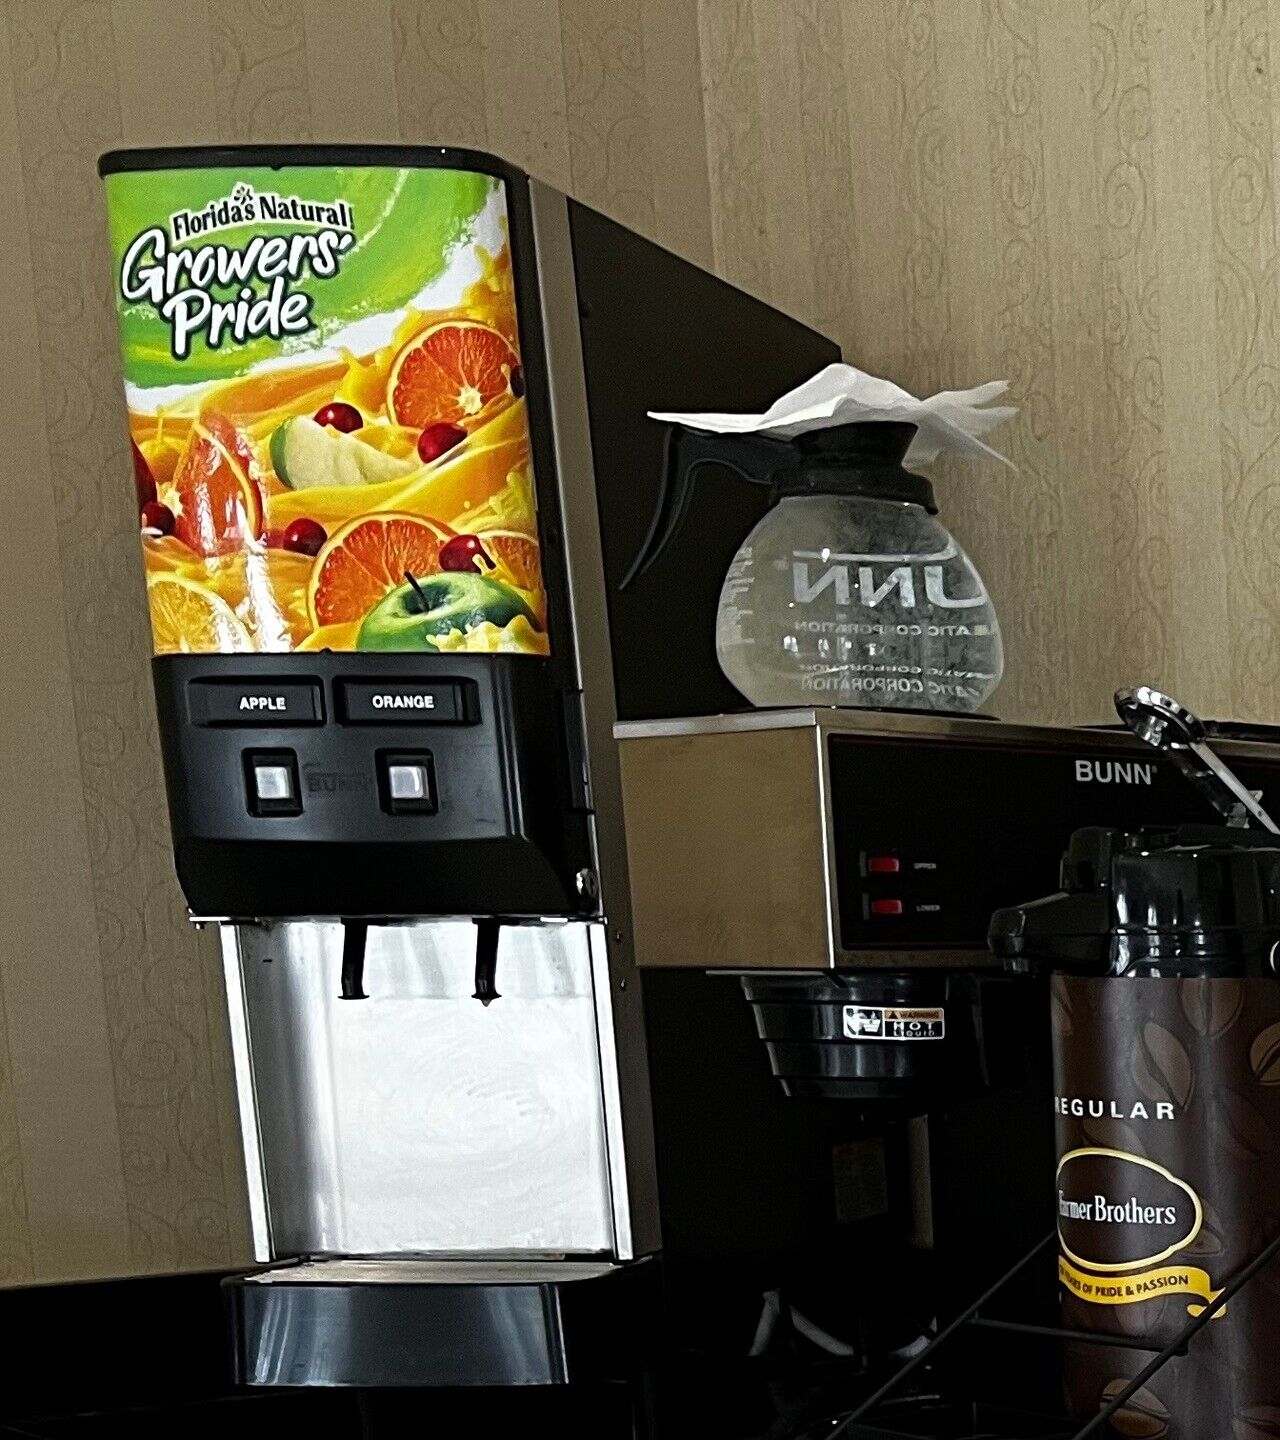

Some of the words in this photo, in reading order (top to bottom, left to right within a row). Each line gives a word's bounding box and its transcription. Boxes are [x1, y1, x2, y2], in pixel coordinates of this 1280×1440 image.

[172, 197, 255, 241] Florida's
[259, 195, 348, 228] Natural
[121, 228, 354, 303] Growers'
[162, 276, 310, 356] Pride
[239, 696, 287, 711] APPLE
[372, 694, 435, 710] ORANGE
[893, 1020, 935, 1032] HOT
[1094, 1195, 1177, 1225] Brothers
[1095, 1285, 1123, 1298] PRIDE
[1125, 1285, 1135, 1296] &
[1136, 1274, 1189, 1295] PASSION
